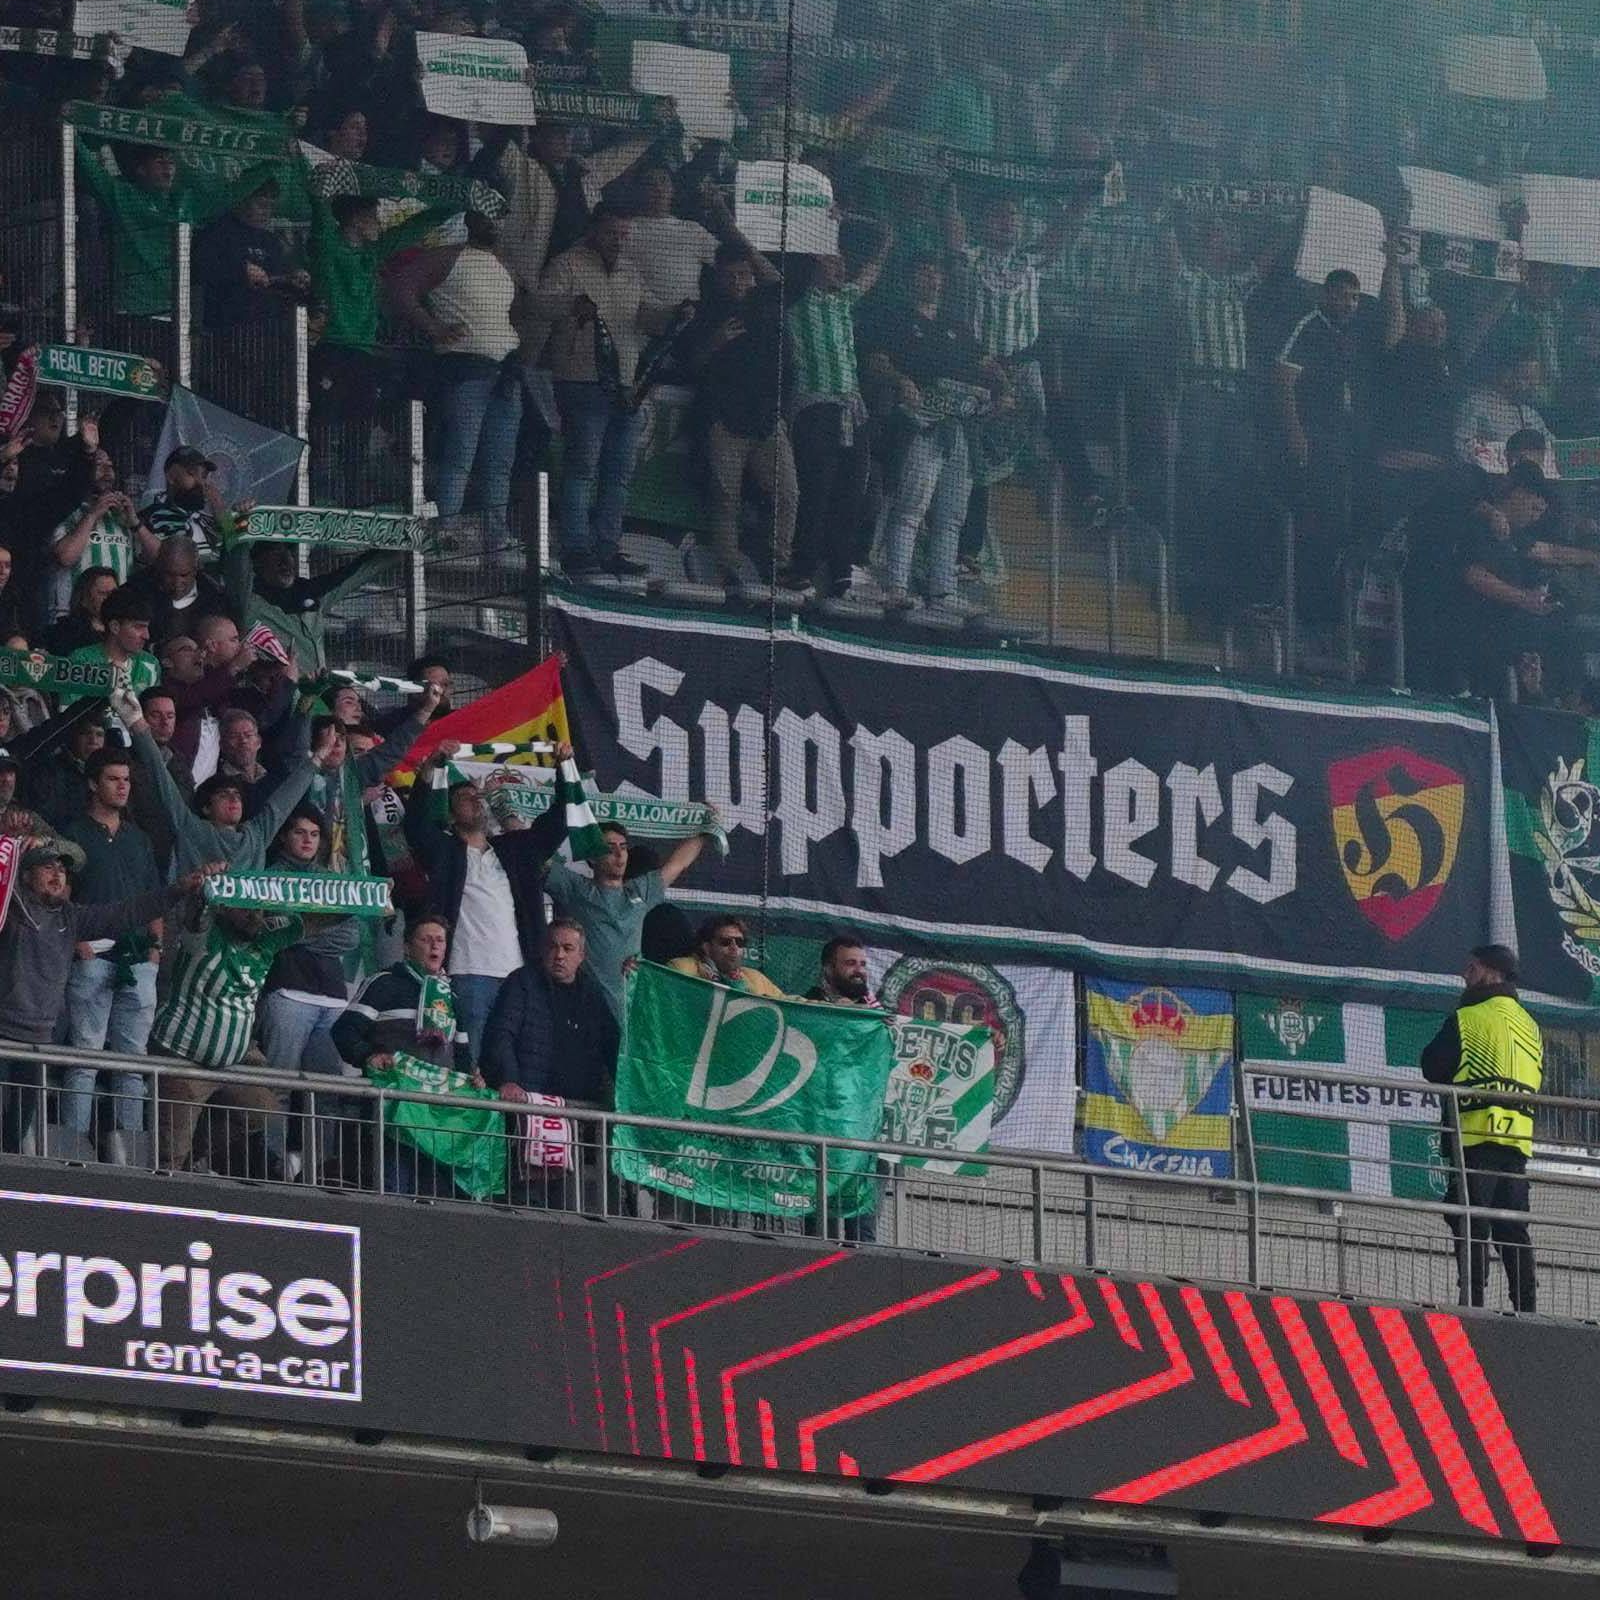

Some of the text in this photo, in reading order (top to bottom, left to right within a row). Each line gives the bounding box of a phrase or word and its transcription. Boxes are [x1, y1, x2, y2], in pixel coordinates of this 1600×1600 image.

[98, 110, 261, 151] REAL BETIS
[49, 348, 127, 382] REAL BETIS
[250, 511, 275, 536] SU
[54, 658, 111, 689] Betis
[612, 656, 1298, 904] Supporters
[239, 876, 389, 906] MONTEQUINTO
[1253, 1076, 1371, 1108] FUENTES
[1379, 1083, 1415, 1107] DE
[678, 1143, 801, 1186] 1907 2007
[0, 1240, 350, 1347] rprise
[123, 1339, 349, 1389] rent-a-car
